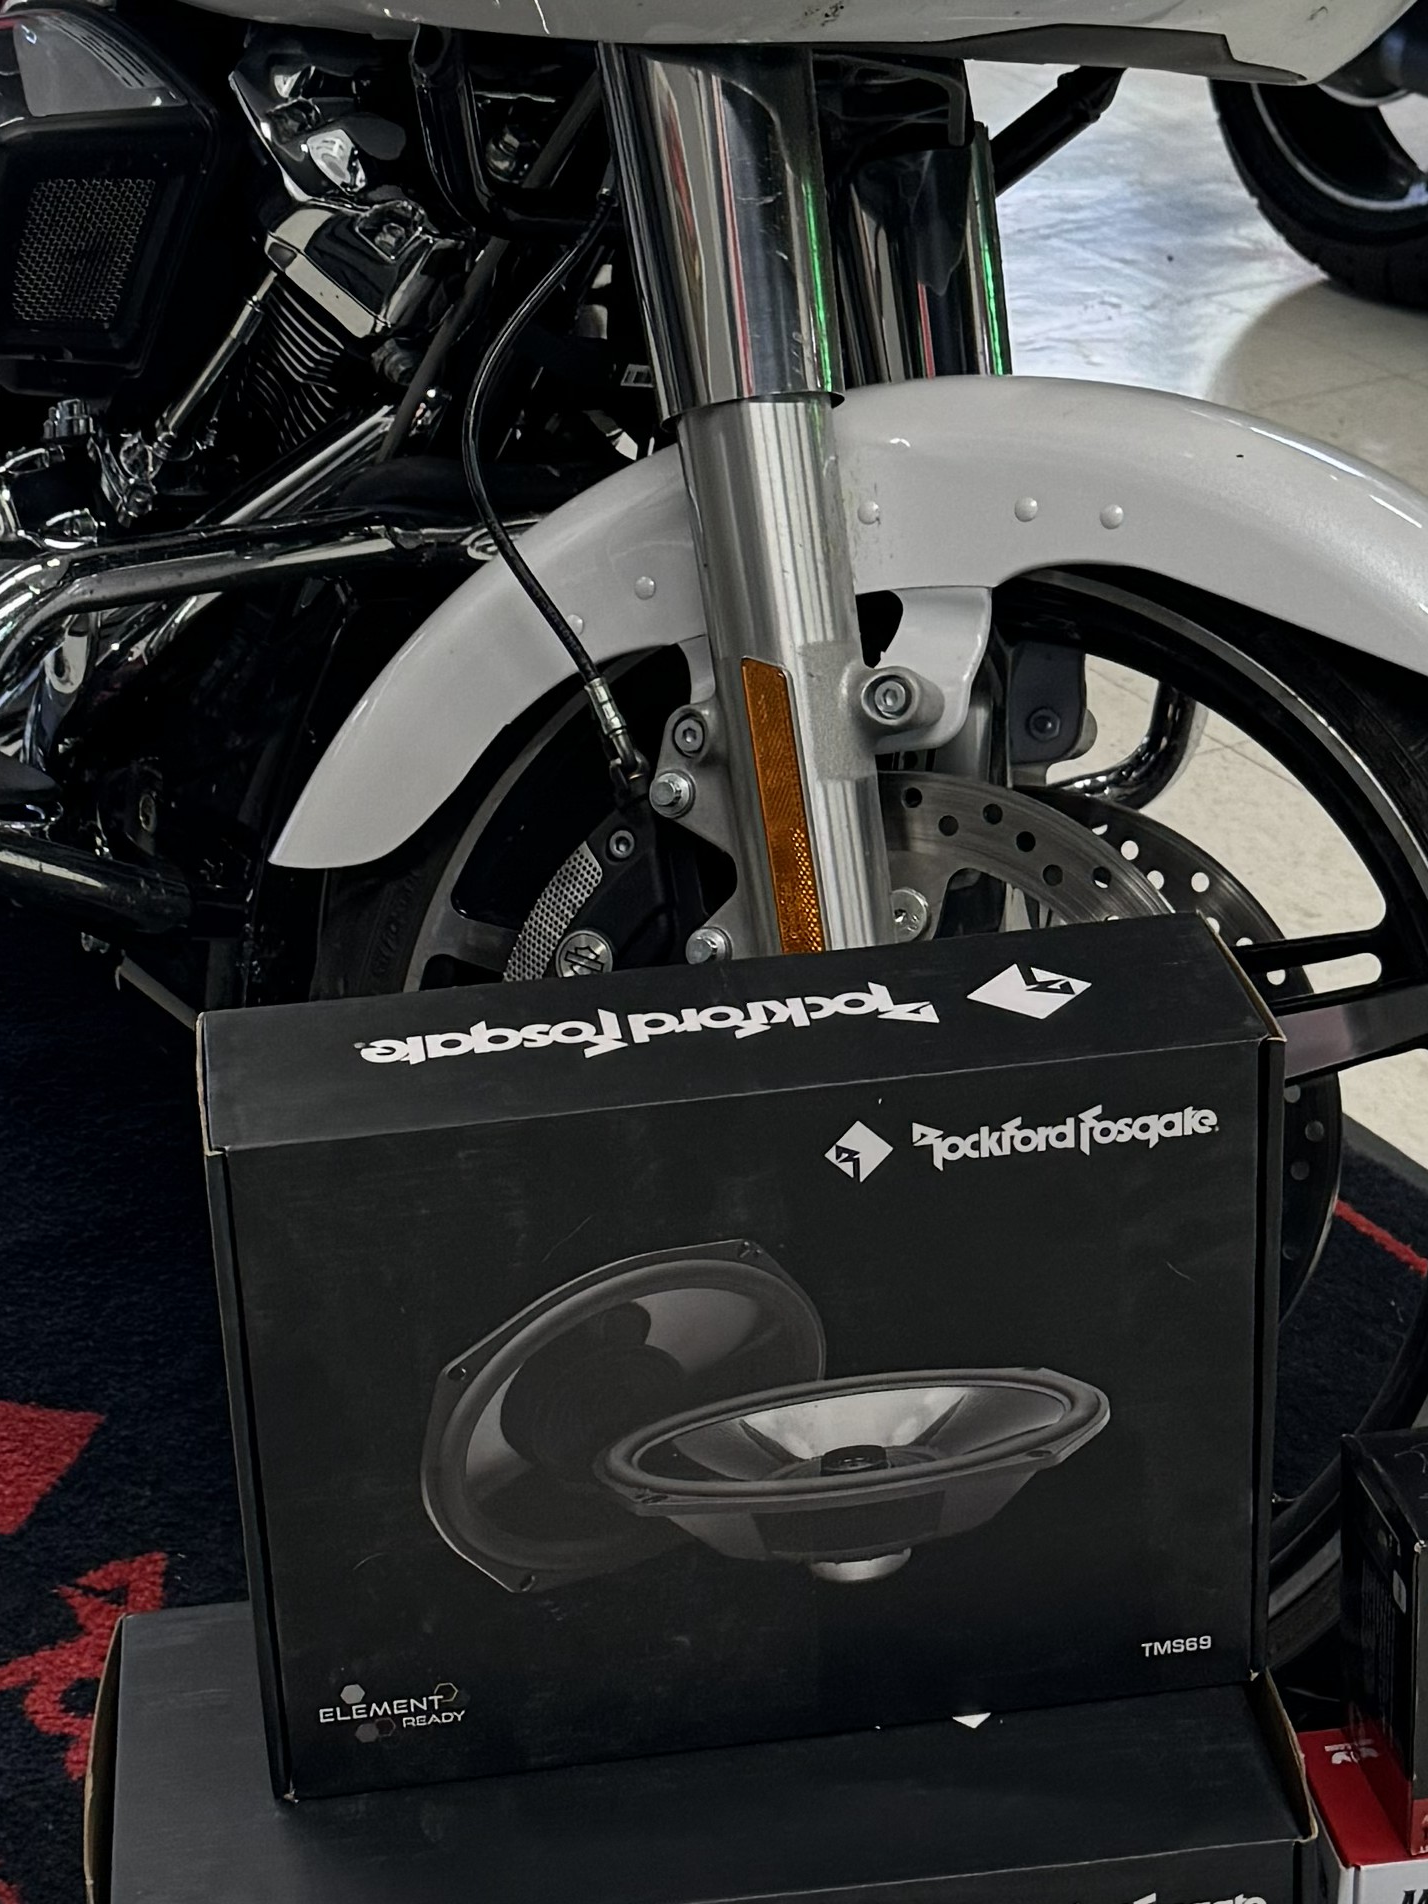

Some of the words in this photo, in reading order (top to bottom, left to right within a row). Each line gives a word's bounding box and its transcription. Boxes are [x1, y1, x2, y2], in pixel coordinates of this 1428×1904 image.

[360, 1008, 628, 1060] Fosgate
[627, 982, 940, 1046] Rockford
[912, 1116, 1075, 1172] Rockford
[1078, 1105, 1219, 1156] Fosgate
[1141, 1635, 1213, 1660] TMS69
[319, 1695, 444, 1724] ELEMENT
[402, 1709, 466, 1729] READY
